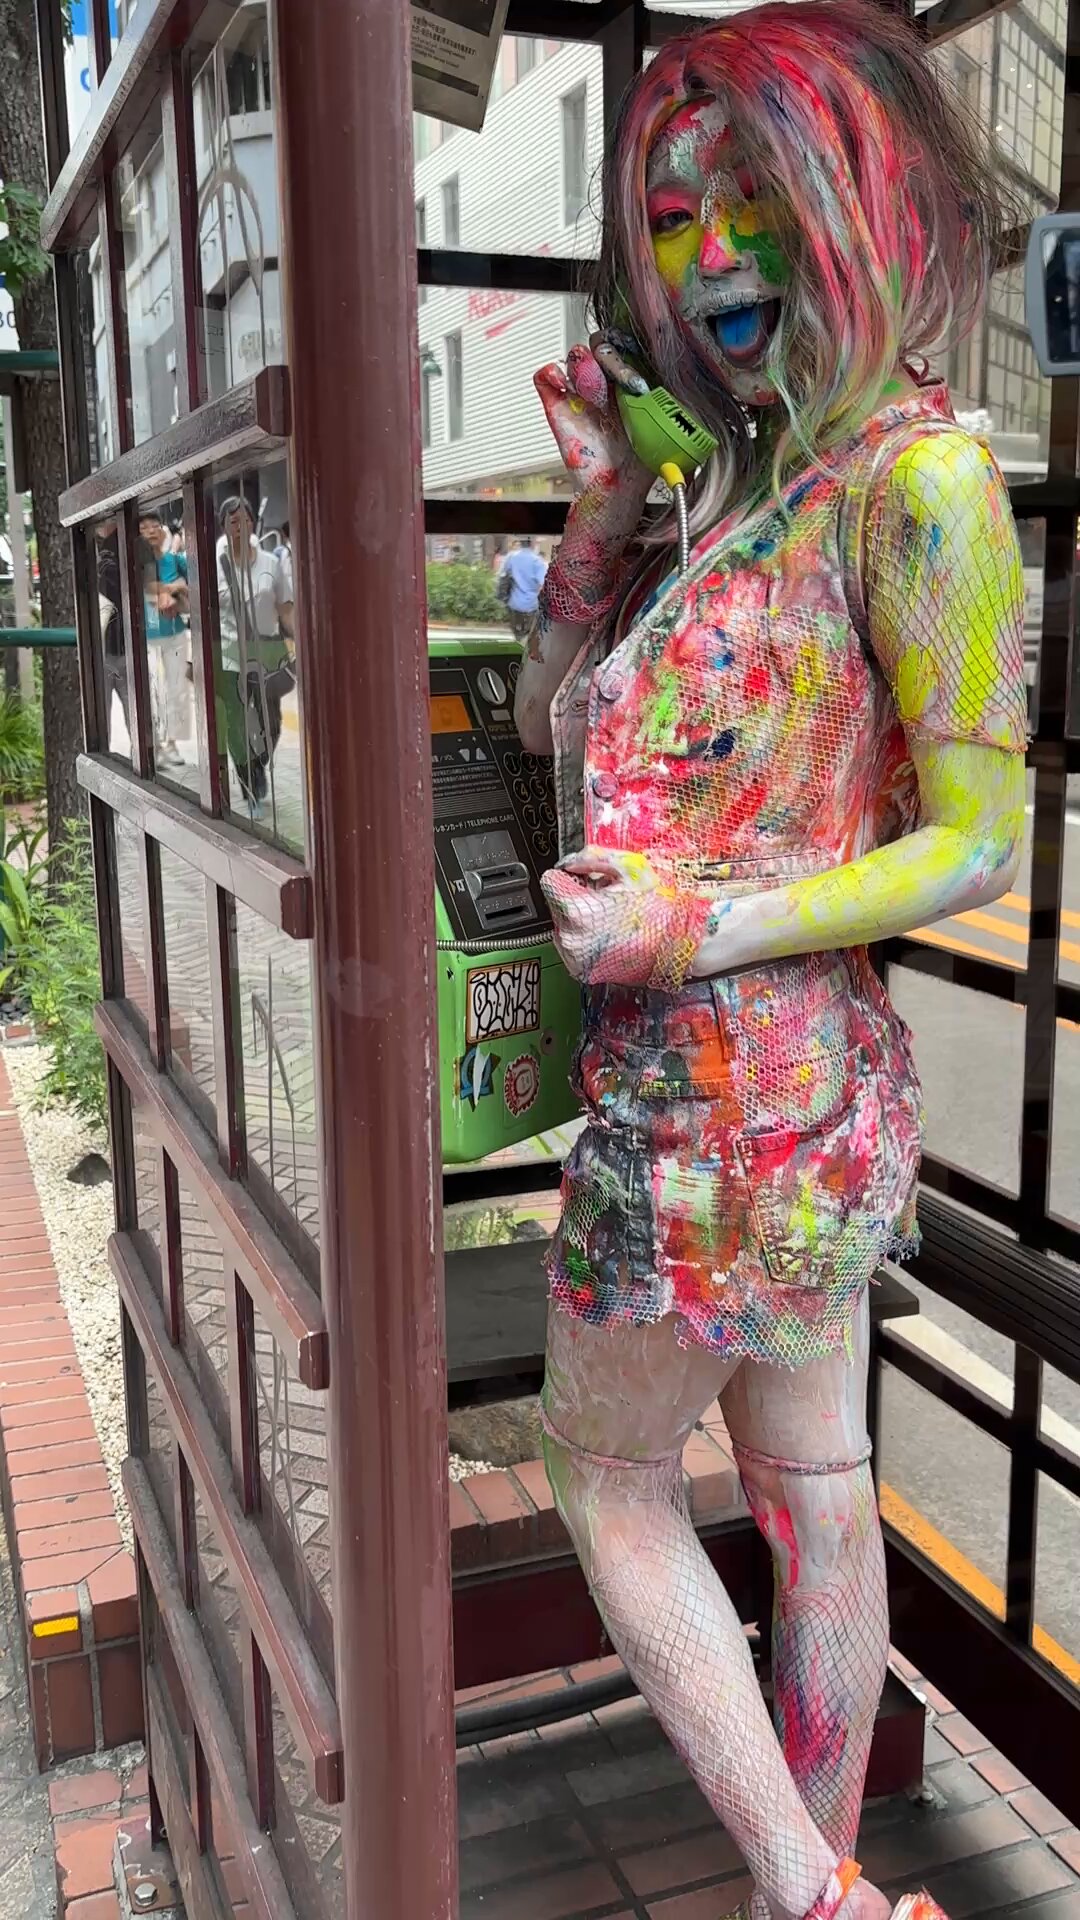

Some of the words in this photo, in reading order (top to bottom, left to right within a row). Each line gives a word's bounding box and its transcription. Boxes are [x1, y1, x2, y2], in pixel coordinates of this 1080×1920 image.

[520, 782, 529, 797] 4
[536, 780, 545, 795] 5
[528, 808, 537, 825] 7
